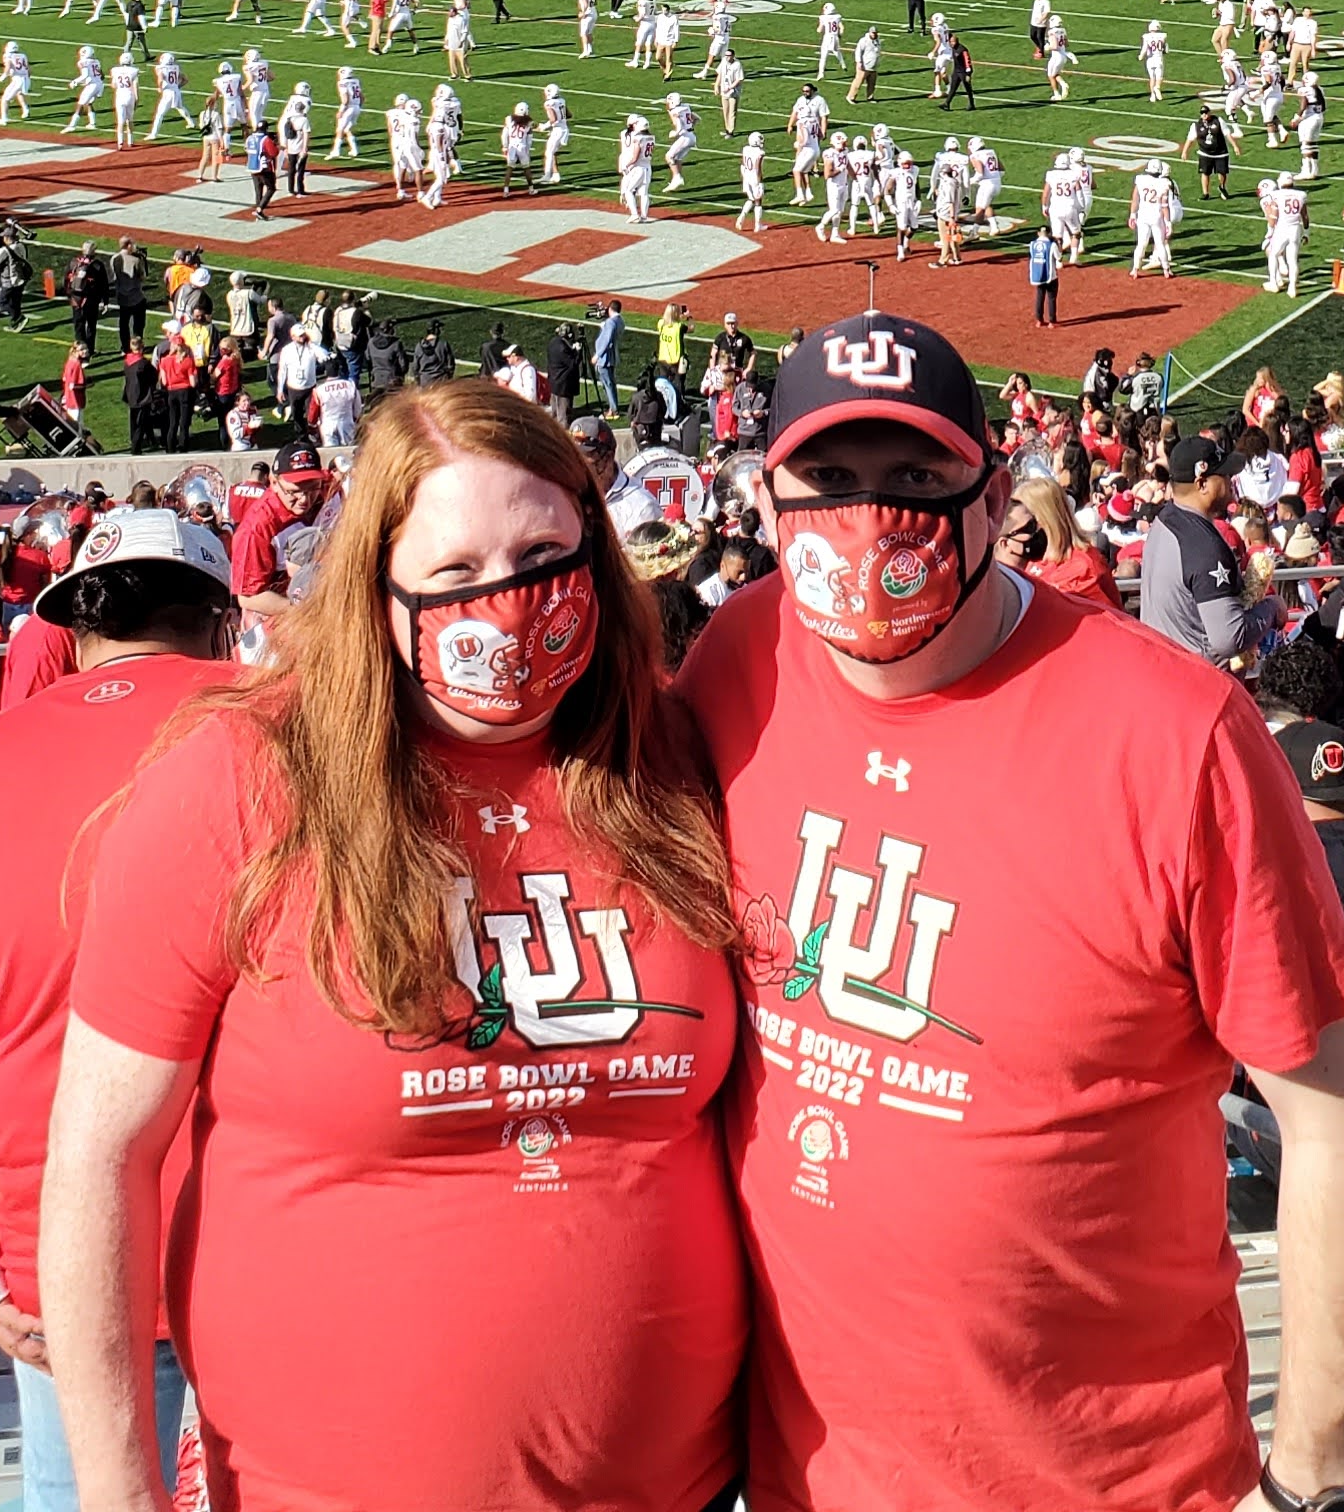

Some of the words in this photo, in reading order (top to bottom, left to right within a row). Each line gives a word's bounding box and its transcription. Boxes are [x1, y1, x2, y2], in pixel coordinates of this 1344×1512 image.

[828, 21, 838, 33] 18
[117, 75, 131, 89] 33
[168, 71, 178, 85] 61
[226, 84, 234, 97] 4
[511, 124, 524, 139] 26
[854, 162, 870, 176] 25
[906, 175, 913, 189] 9
[1056, 182, 1072, 197] 53
[1143, 188, 1157, 204] 72
[1284, 198, 1300, 214] 59
[858, 548, 879, 591] ROSE
[878, 531, 915, 552] BOWL
[917, 535, 950, 574] GAME
[525, 617, 545, 660] ROSE
[541, 587, 574, 617] BOWL
[891, 604, 951, 628] Northwestern
[892, 622, 926, 638] Mutual
[457, 638, 477, 659] U
[548, 667, 577, 689] Mutual
[798, 1020, 875, 1078] BOWL
[401, 1063, 487, 1097] ROSE
[498, 1060, 595, 1091] BOWL
[796, 1059, 864, 1106] 2022
[505, 1086, 586, 1113] 2022
[552, 1112, 573, 1146] GAME
[807, 1104, 835, 1124] BOWL
[834, 1120, 849, 1161] GAME
